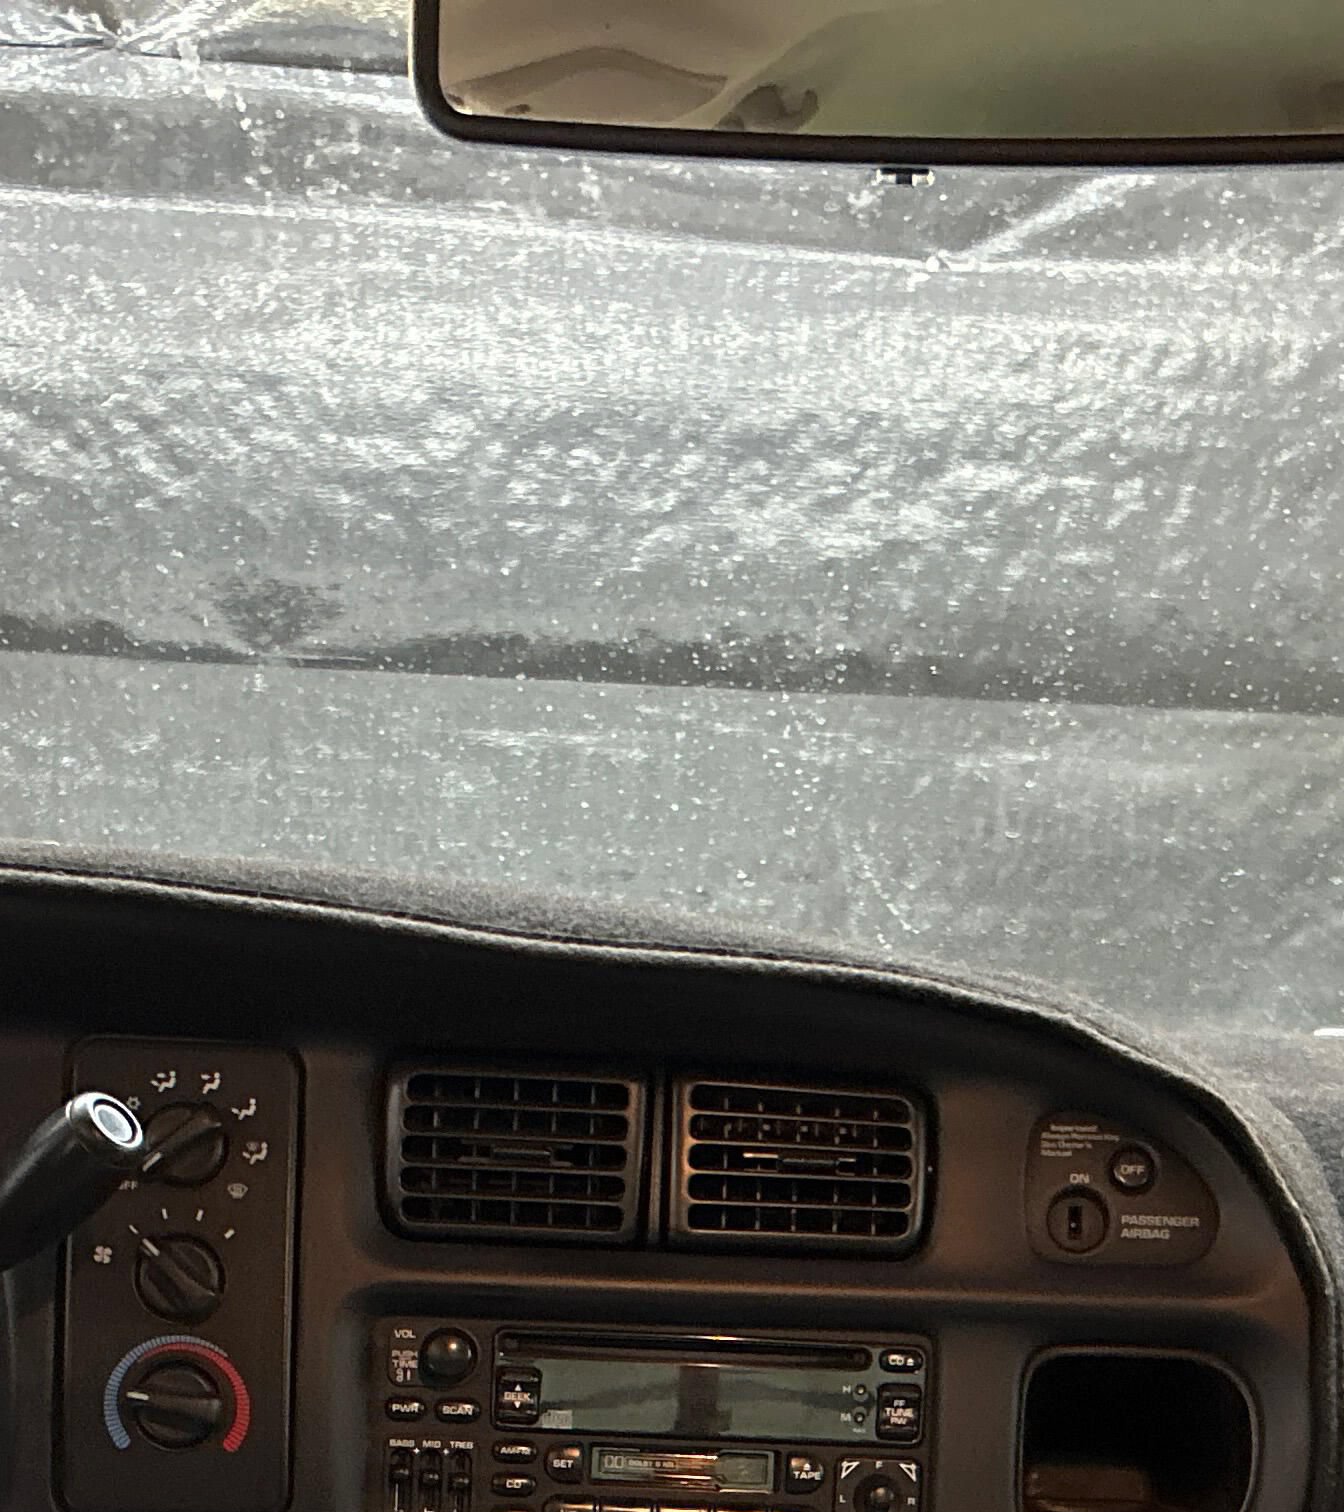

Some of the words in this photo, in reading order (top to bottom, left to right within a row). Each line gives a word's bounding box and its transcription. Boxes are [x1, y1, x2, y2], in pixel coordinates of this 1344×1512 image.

[1120, 1164, 1145, 1176] OFF
[1069, 1173, 1090, 1184] ON
[1121, 1215, 1200, 1228] PASSENGER
[1120, 1228, 1170, 1240] AIRBAG
[394, 1329, 416, 1339] VOL
[888, 1355, 904, 1366] CD
[392, 1403, 419, 1413] PWR
[442, 1405, 474, 1415] SCAN
[885, 1407, 913, 1418] TUNE
[389, 1439, 415, 1448] BASS
[422, 1440, 442, 1449] MID
[450, 1441, 474, 1449] TREB
[553, 1459, 574, 1468] SET
[793, 1470, 821, 1481] TAPE
[506, 1480, 523, 1489] CD
